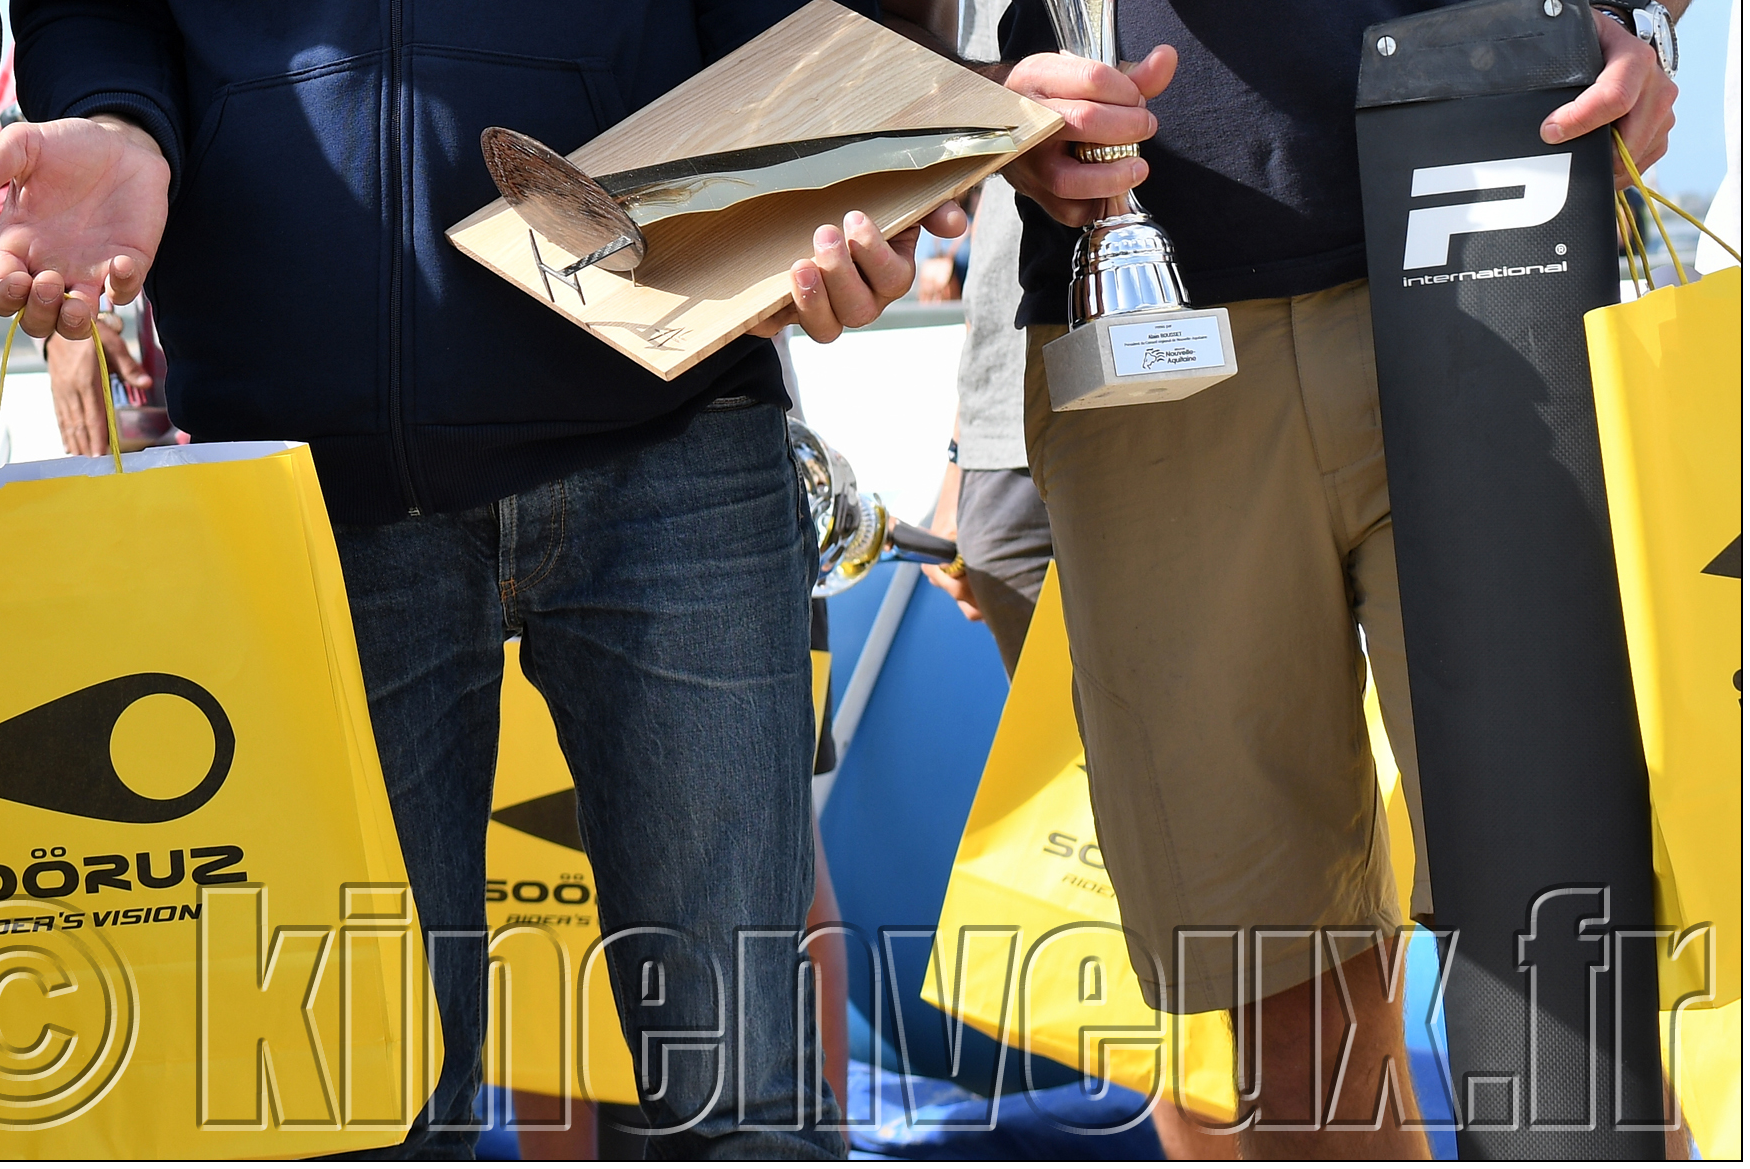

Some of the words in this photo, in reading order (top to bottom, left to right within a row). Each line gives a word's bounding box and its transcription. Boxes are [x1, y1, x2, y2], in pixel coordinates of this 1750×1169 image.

[1403, 260, 1568, 288] international
[1167, 356, 1197, 365] Aquitaine
[92, 903, 203, 928] VISION
